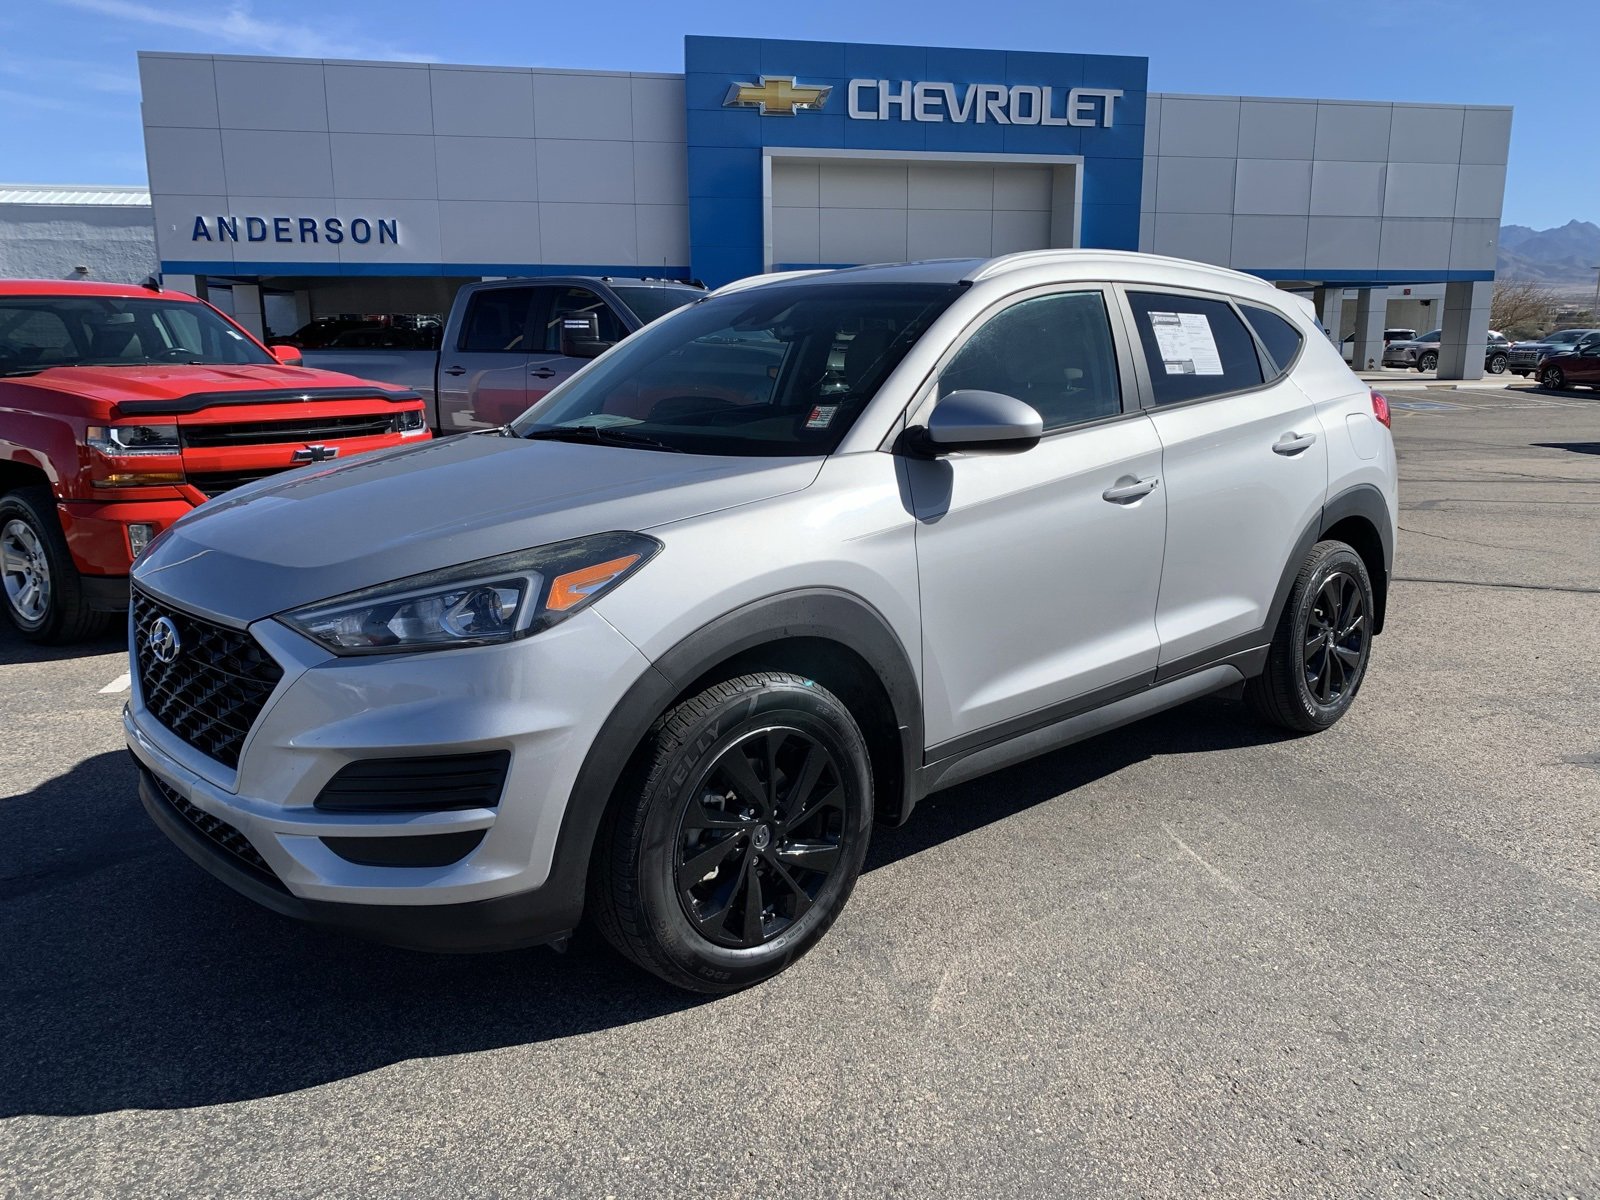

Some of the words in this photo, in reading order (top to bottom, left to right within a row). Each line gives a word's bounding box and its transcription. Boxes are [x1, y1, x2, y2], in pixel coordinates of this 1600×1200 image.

[848, 78, 1124, 127] CHEVROLET
[191, 216, 400, 244] ANDERSON
[662, 719, 721, 801] KELLY
